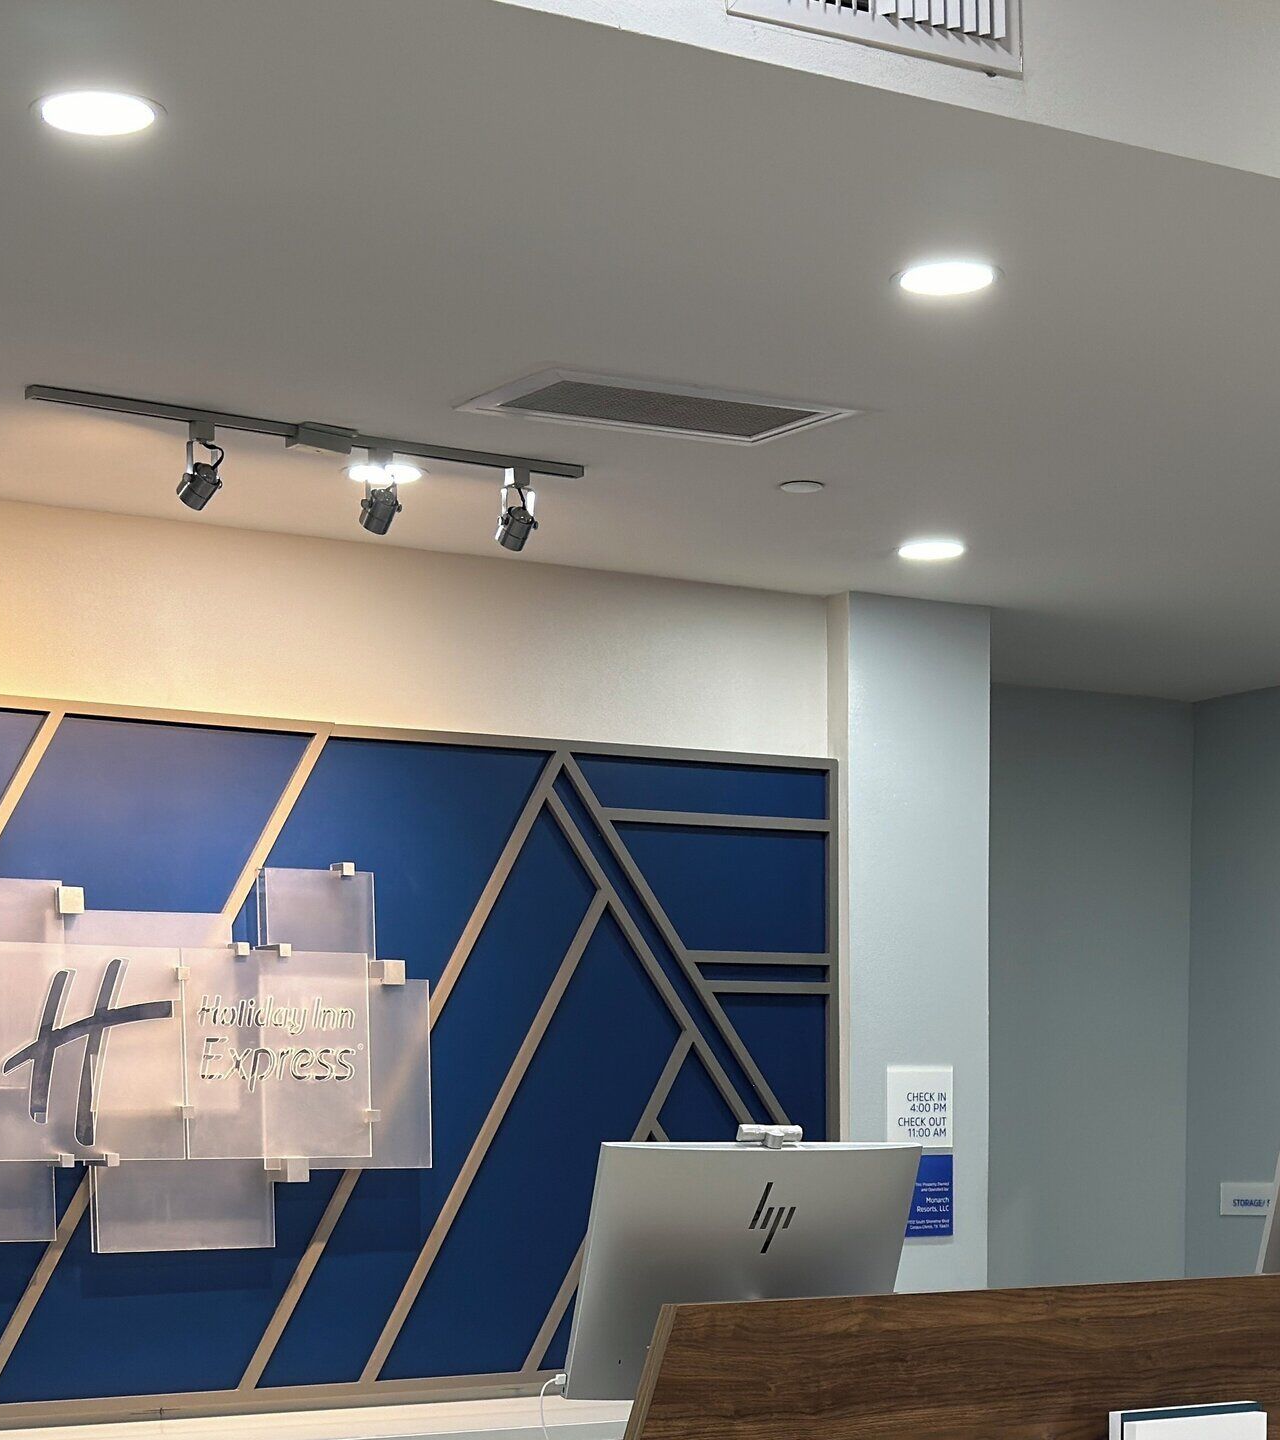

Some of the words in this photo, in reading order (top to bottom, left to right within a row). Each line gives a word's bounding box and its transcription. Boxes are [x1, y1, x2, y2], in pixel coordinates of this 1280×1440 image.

[197, 995, 308, 1036] Holiday
[312, 997, 356, 1031] Inn
[906, 1092, 935, 1102] CHECK
[937, 1092, 947, 1101] IN
[910, 1103, 931, 1113] 4:00
[933, 1103, 947, 1112] PM
[897, 1117, 926, 1127] CHECK
[928, 1116, 947, 1127] OUT
[908, 1128, 931, 1137] 11:00
[933, 1128, 947, 1137] AM
[916, 1205, 938, 1213] Resorts,
